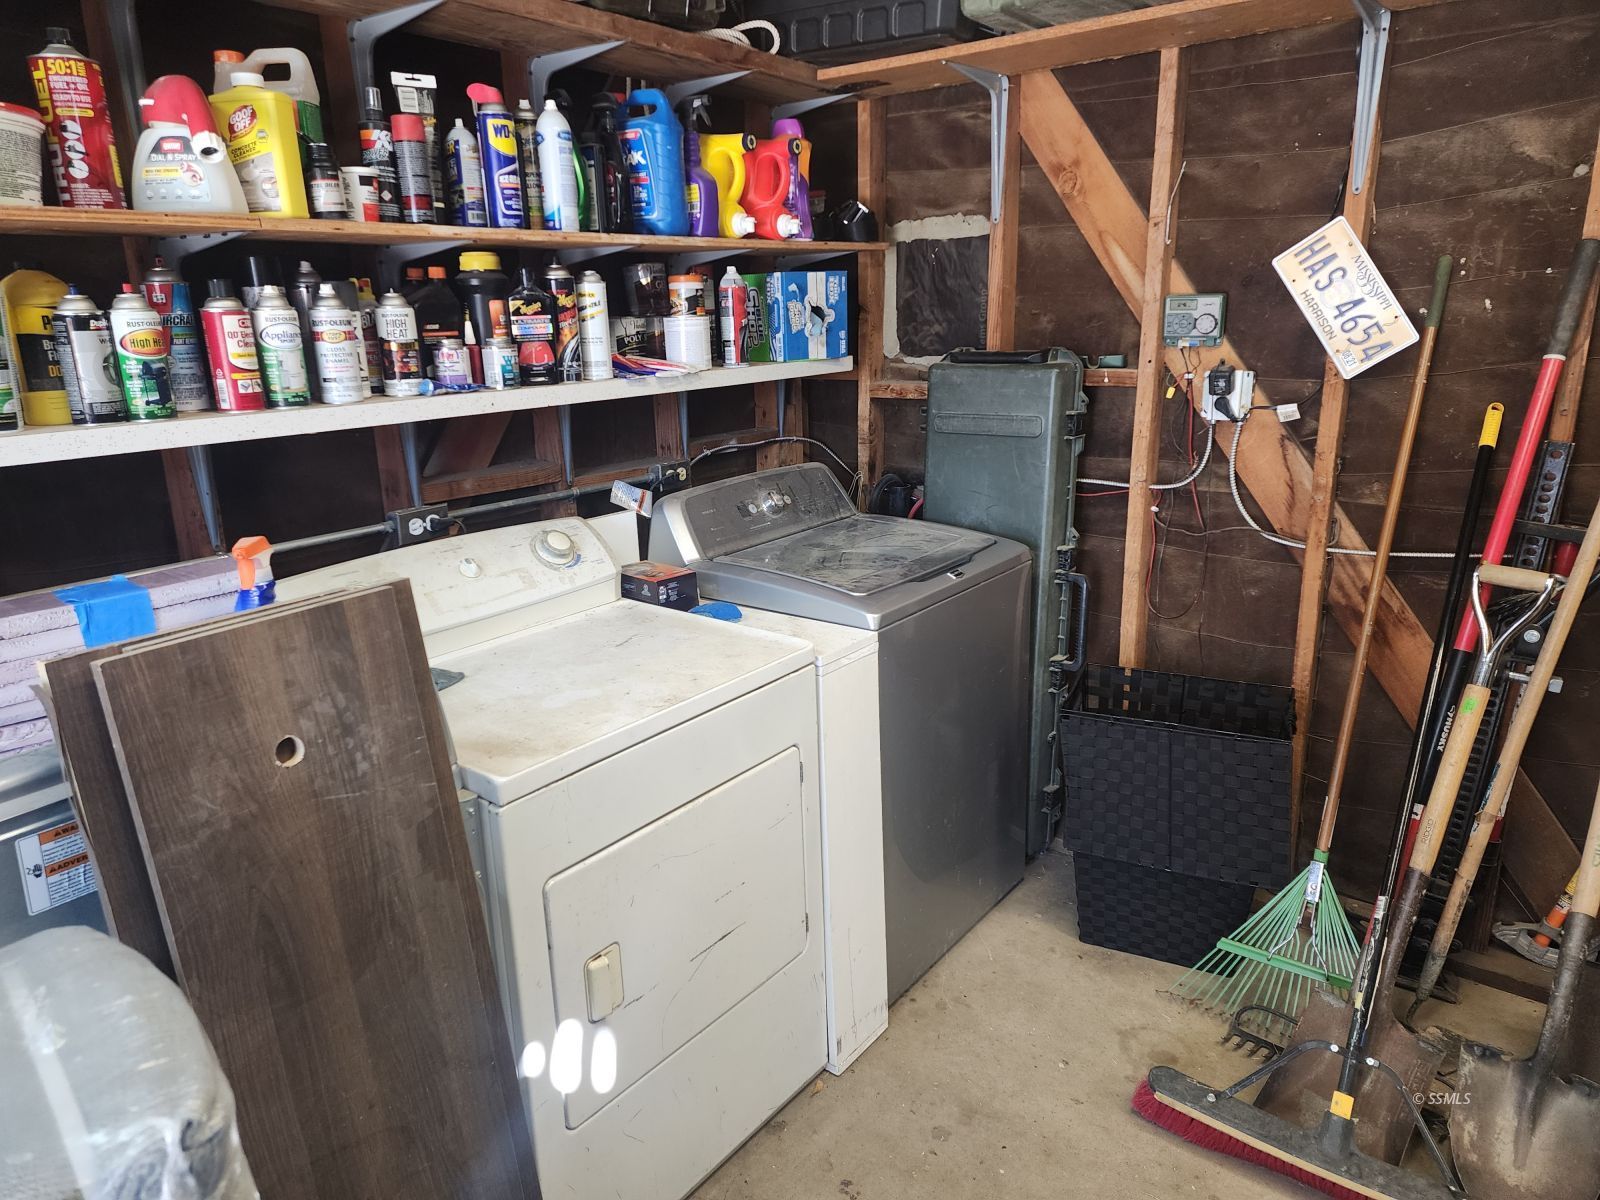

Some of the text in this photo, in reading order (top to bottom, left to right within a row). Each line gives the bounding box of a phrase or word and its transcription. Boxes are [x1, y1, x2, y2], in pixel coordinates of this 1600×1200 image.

[46, 59, 77, 75] 50:1
[229, 106, 254, 124] GOOF
[233, 119, 252, 132] OFF
[1351, 255, 1393, 310] MISSISSIPPI
[1294, 234, 1394, 363] HAS 4654
[385, 319, 407, 328] HIGH
[747, 287, 761, 348] SHOP
[1300, 289, 1338, 340] HARRISON
[130, 338, 151, 348] High
[386, 329, 408, 339] HEAT
[1437, 715, 1454, 752] HUSKY
